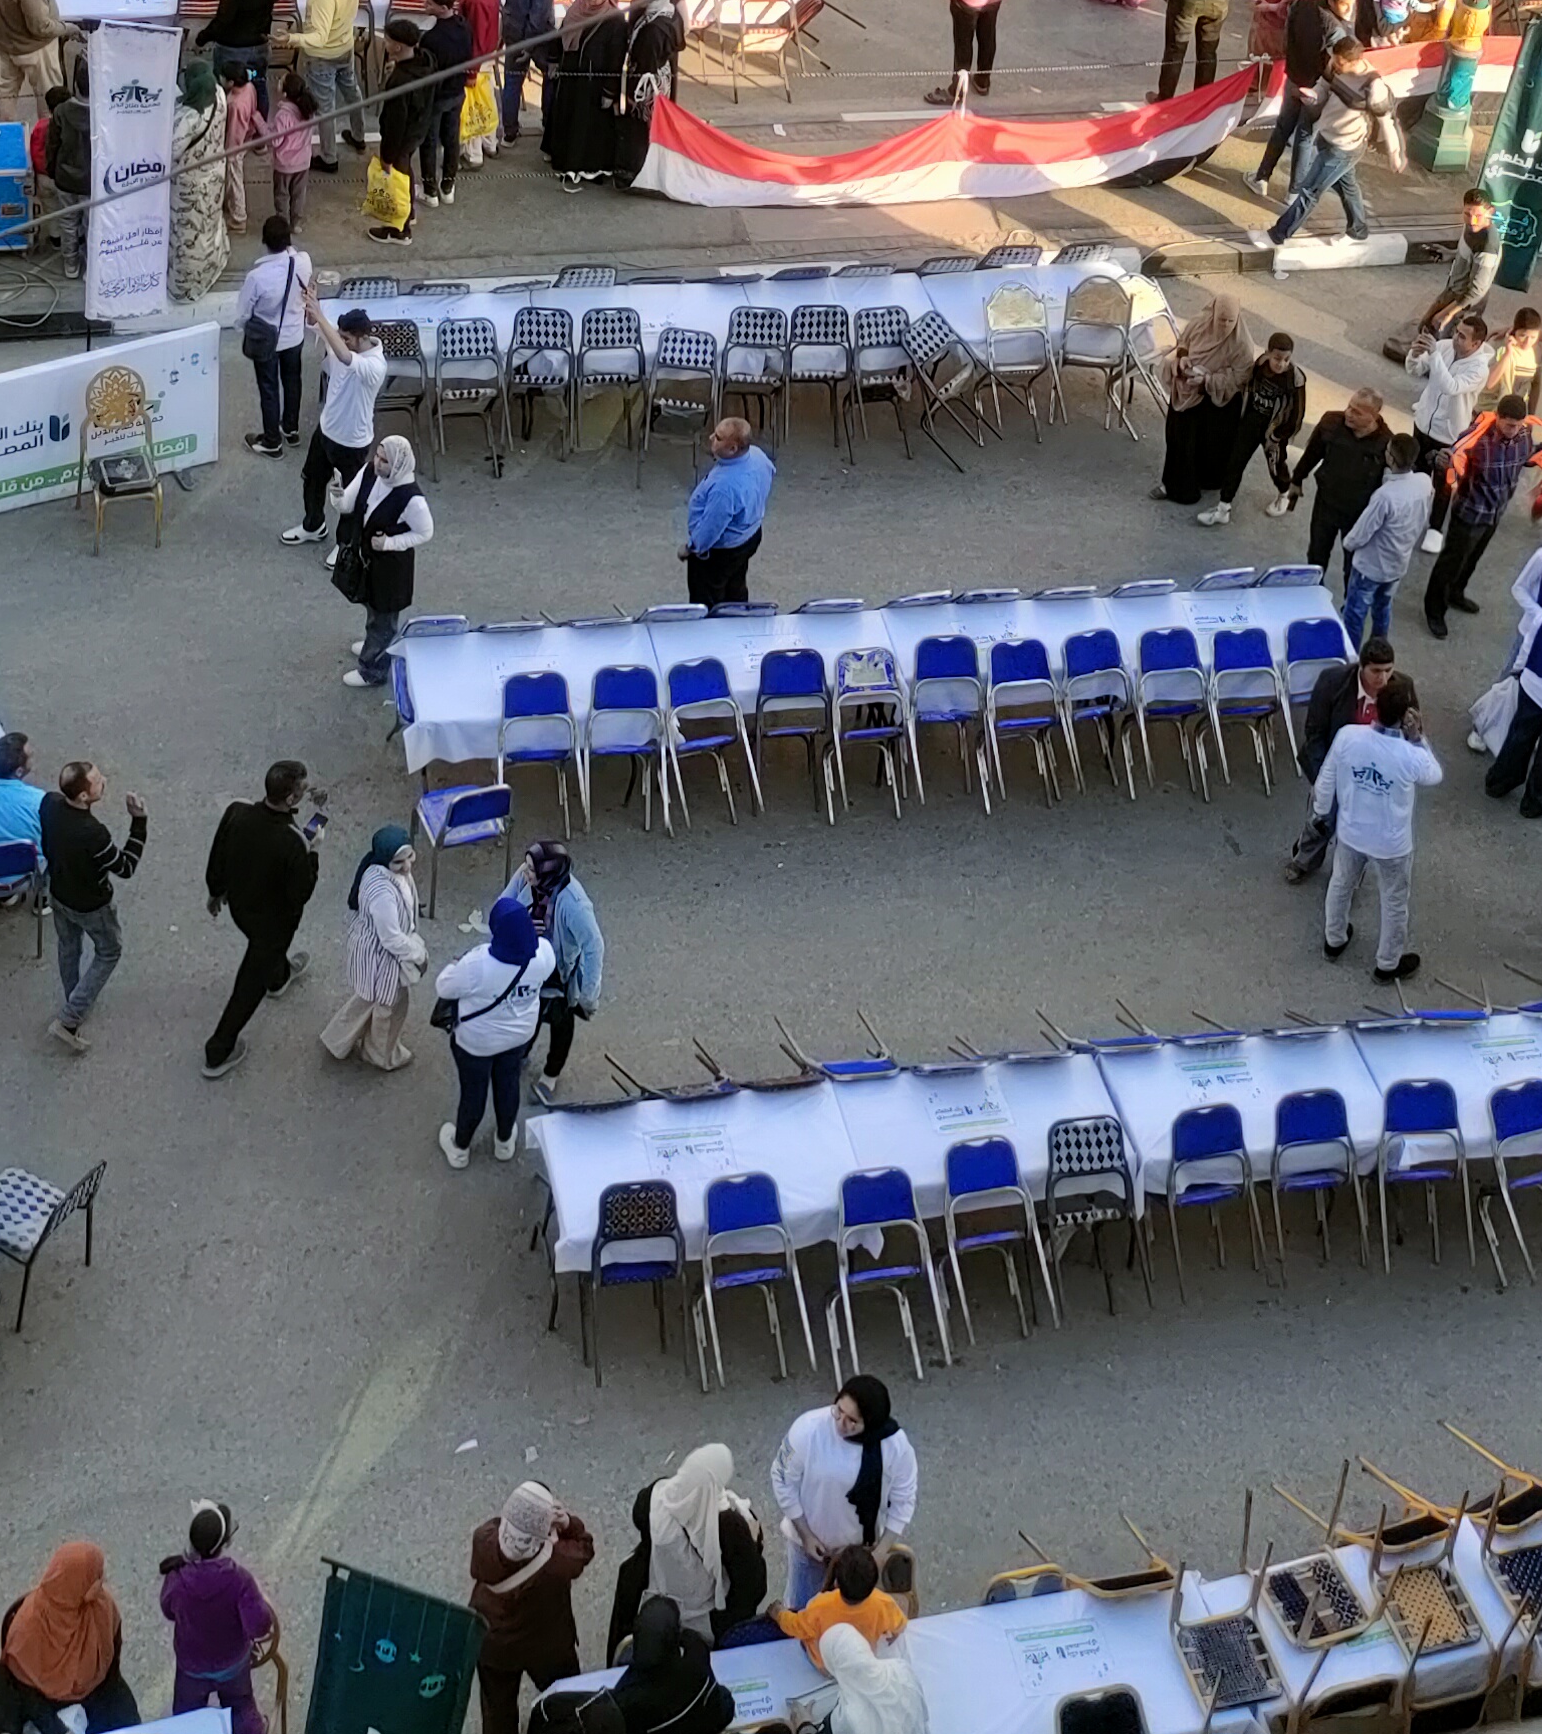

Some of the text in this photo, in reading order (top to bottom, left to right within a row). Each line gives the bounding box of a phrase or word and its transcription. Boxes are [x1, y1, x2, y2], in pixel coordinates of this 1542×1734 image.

[1489, 149, 1534, 169] الطعام
[13, 420, 44, 433] بنك
[21, 475, 44, 489] من
